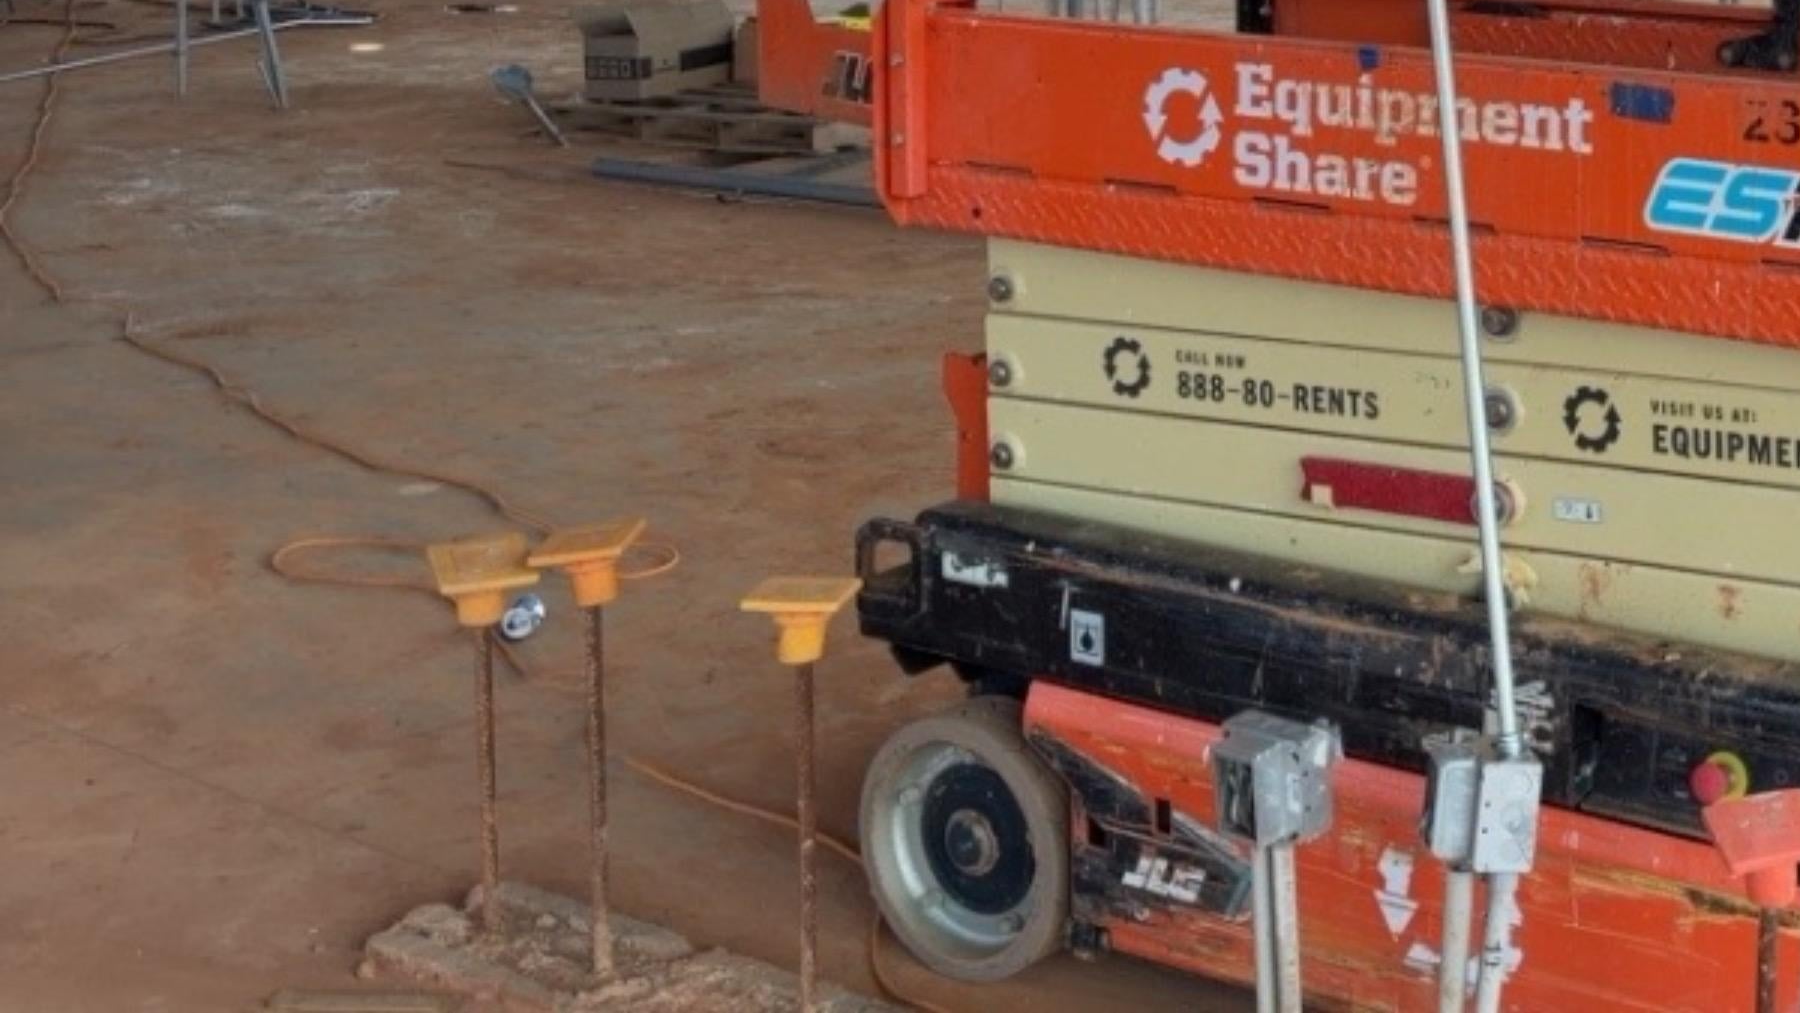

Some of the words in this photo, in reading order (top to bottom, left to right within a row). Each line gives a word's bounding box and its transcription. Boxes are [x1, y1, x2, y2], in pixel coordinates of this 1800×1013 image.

[1233, 62, 1595, 155] Equipment
[1232, 129, 1418, 206] Share
[1176, 370, 1380, 420] 888-80-RENTS
[1649, 400, 1695, 418] VISIT
[1702, 405, 1724, 421] US
